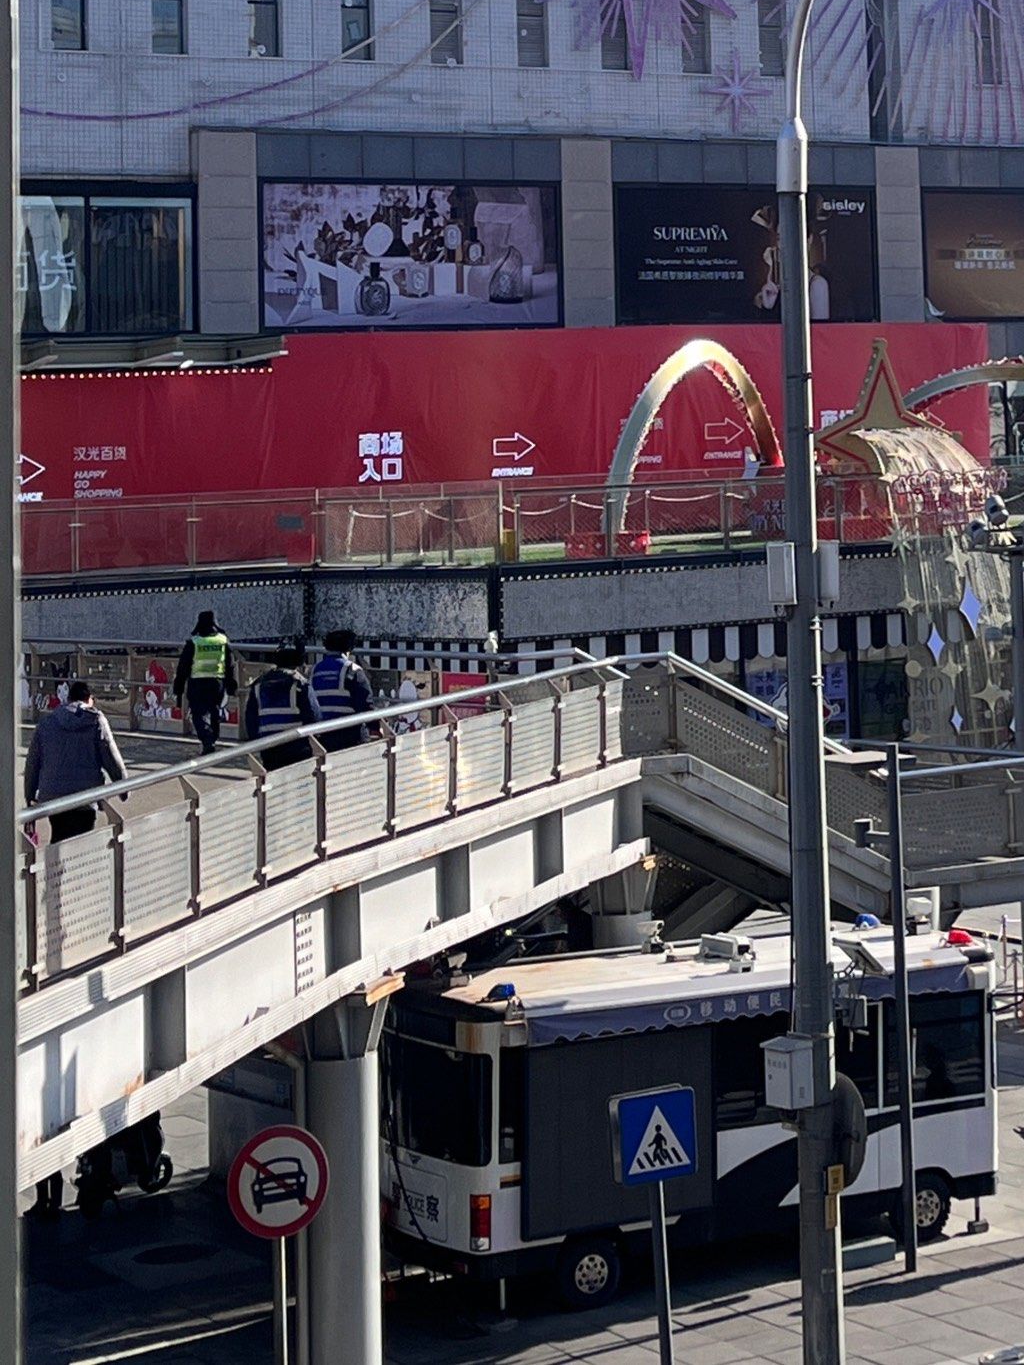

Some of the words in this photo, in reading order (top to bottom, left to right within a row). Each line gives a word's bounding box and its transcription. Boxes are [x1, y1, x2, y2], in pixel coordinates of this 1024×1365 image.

[822, 199, 866, 213] sisley
[359, 432, 403, 457] 商场
[73, 446, 127, 461] 汉光百货
[704, 450, 743, 460] ENTRANCE
[74, 470, 107, 479] HAPPY
[359, 458, 402, 482] 入口
[491, 466, 534, 477] ENTRANCE
[74, 480, 90, 489] GO
[74, 488, 123, 499] SHOPPING
[700, 991, 783, 1018] 移动便民
